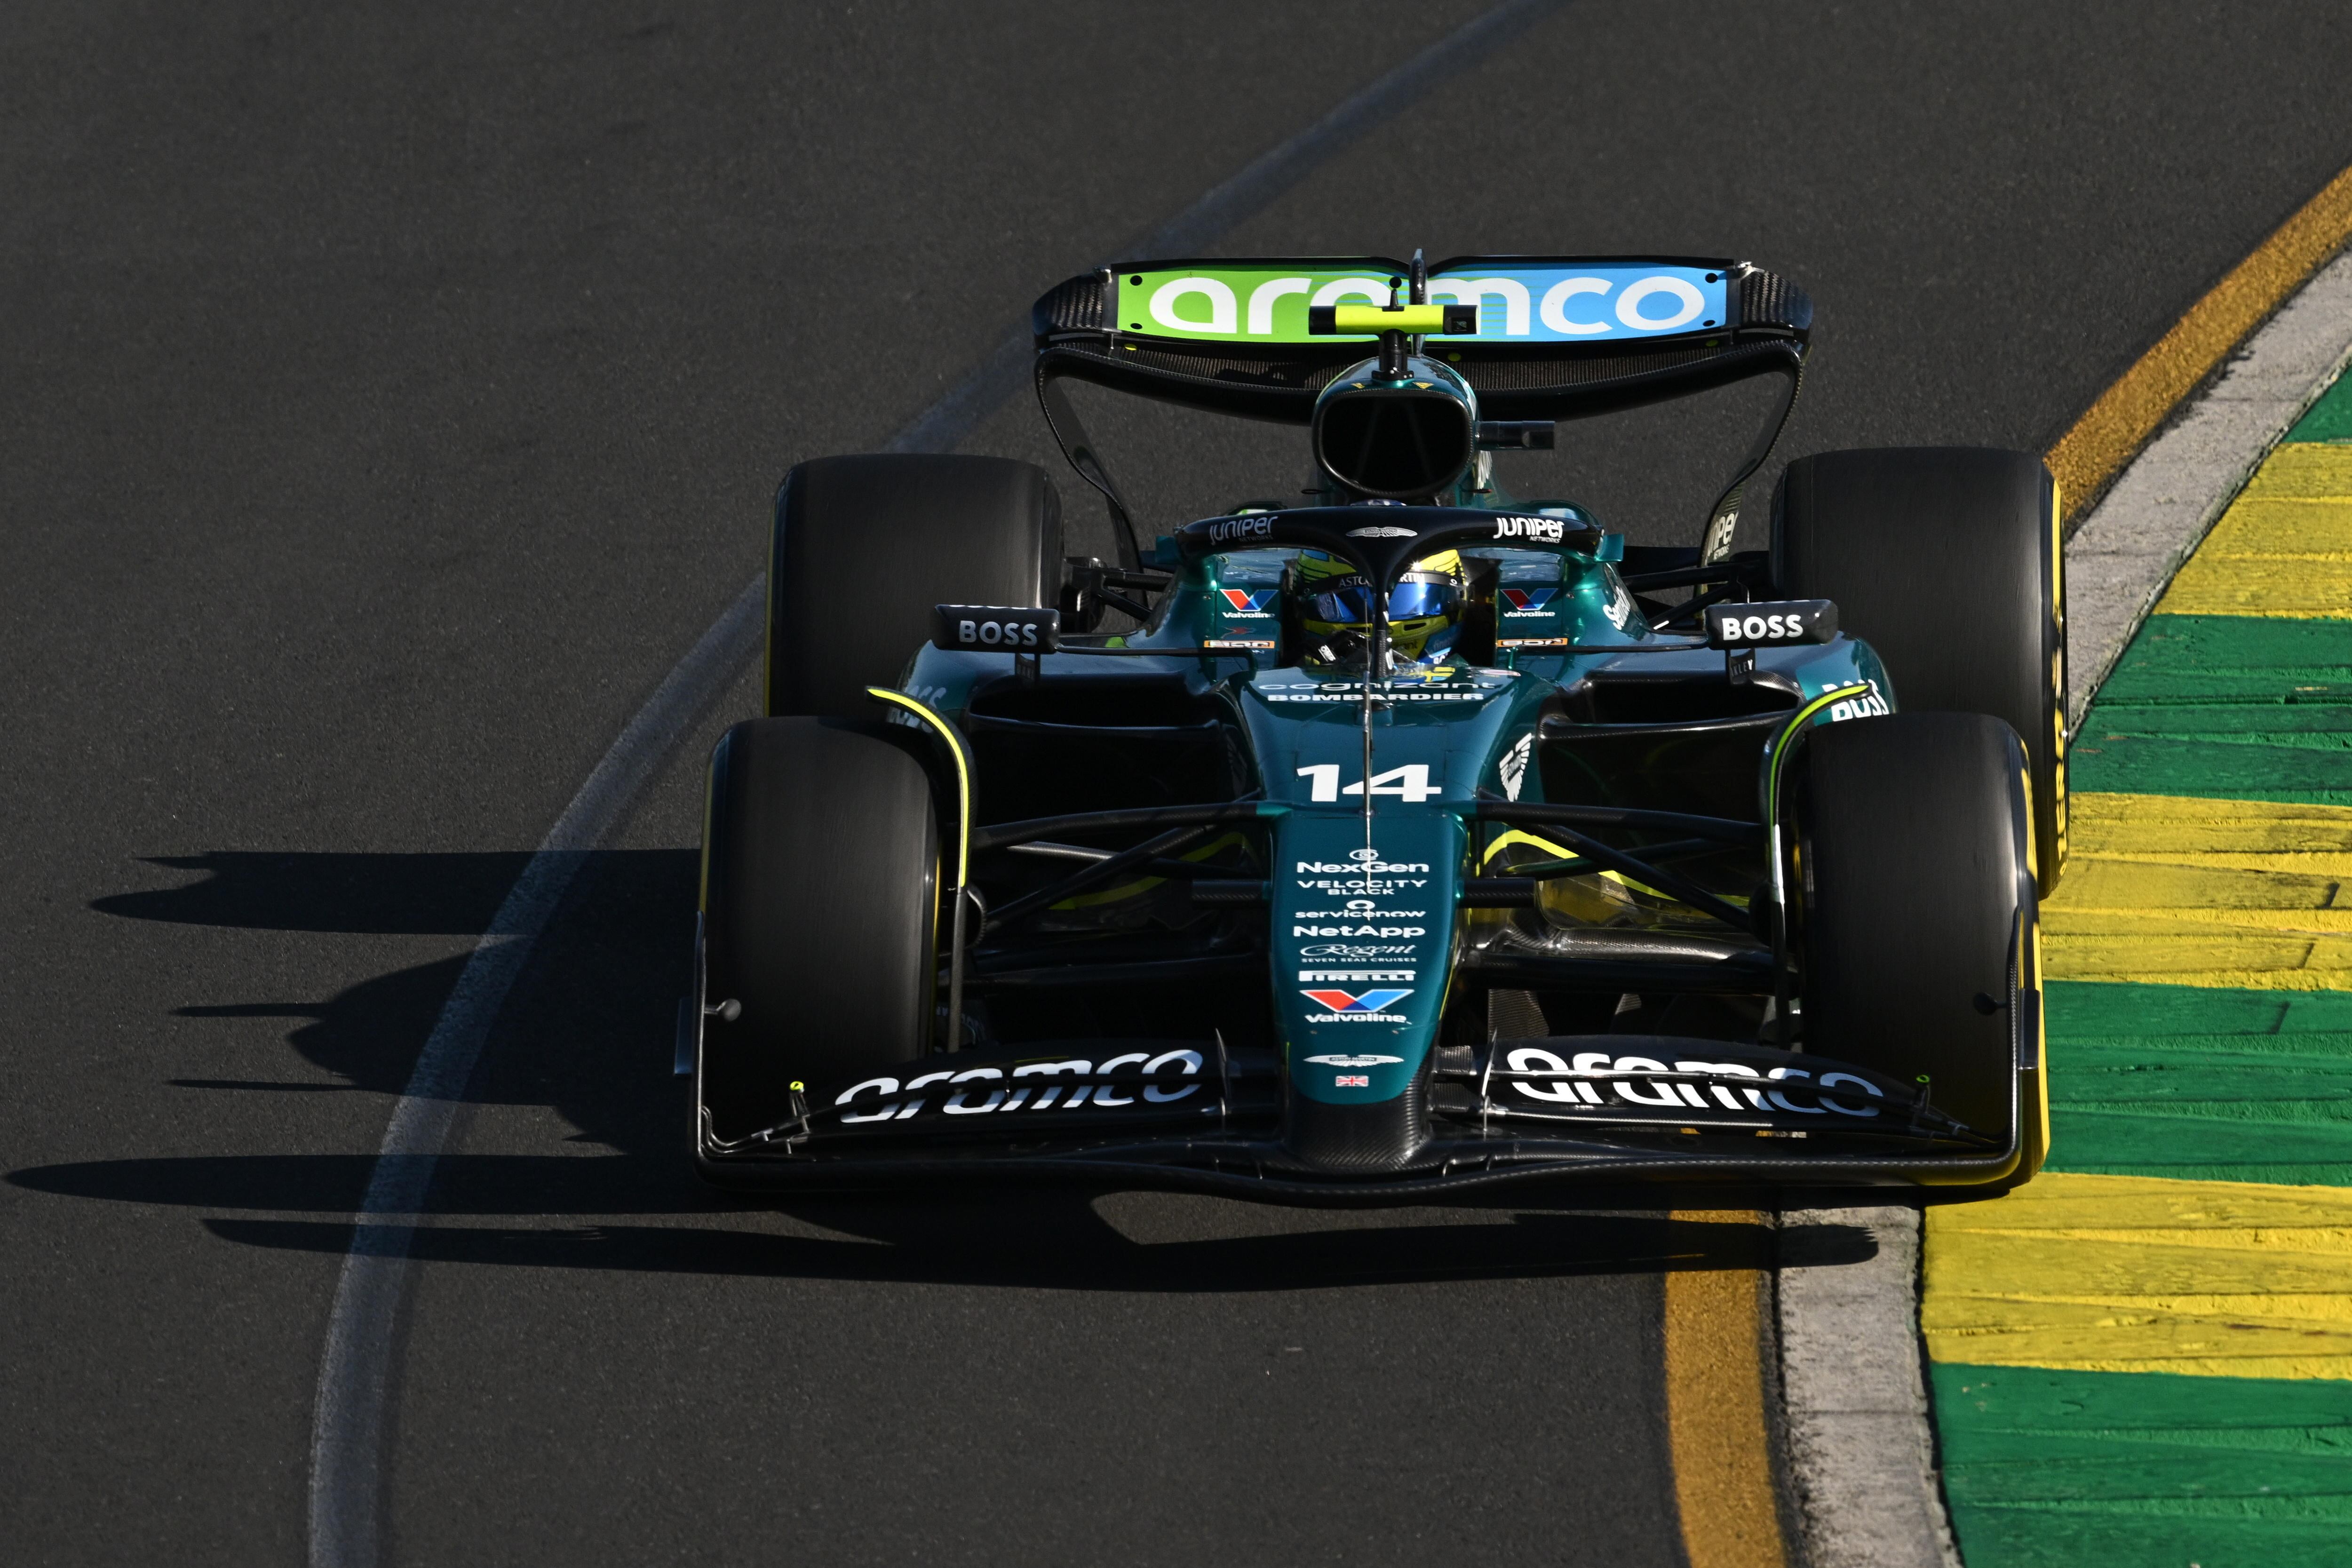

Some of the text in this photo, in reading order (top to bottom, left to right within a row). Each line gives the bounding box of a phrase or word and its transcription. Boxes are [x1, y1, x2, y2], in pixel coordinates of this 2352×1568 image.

[959, 620, 1038, 646] BOSS
[1722, 615, 1804, 641] BOSS
[1258, 681, 1495, 691] cognizant
[1297, 764, 1441, 802] 14
[1297, 861, 1430, 873] NexGen
[1297, 880, 1428, 888] VELOCITY
[1295, 909, 1426, 918] servicenow
[1294, 925, 1426, 938] NetApp
[1300, 944, 1417, 958] Regent
[1298, 970, 1416, 982] PIRELLI
[1305, 1013, 1407, 1023] Valvoline
[835, 1049, 1203, 1123] aramco
[1507, 1048, 1883, 1117] aramco
